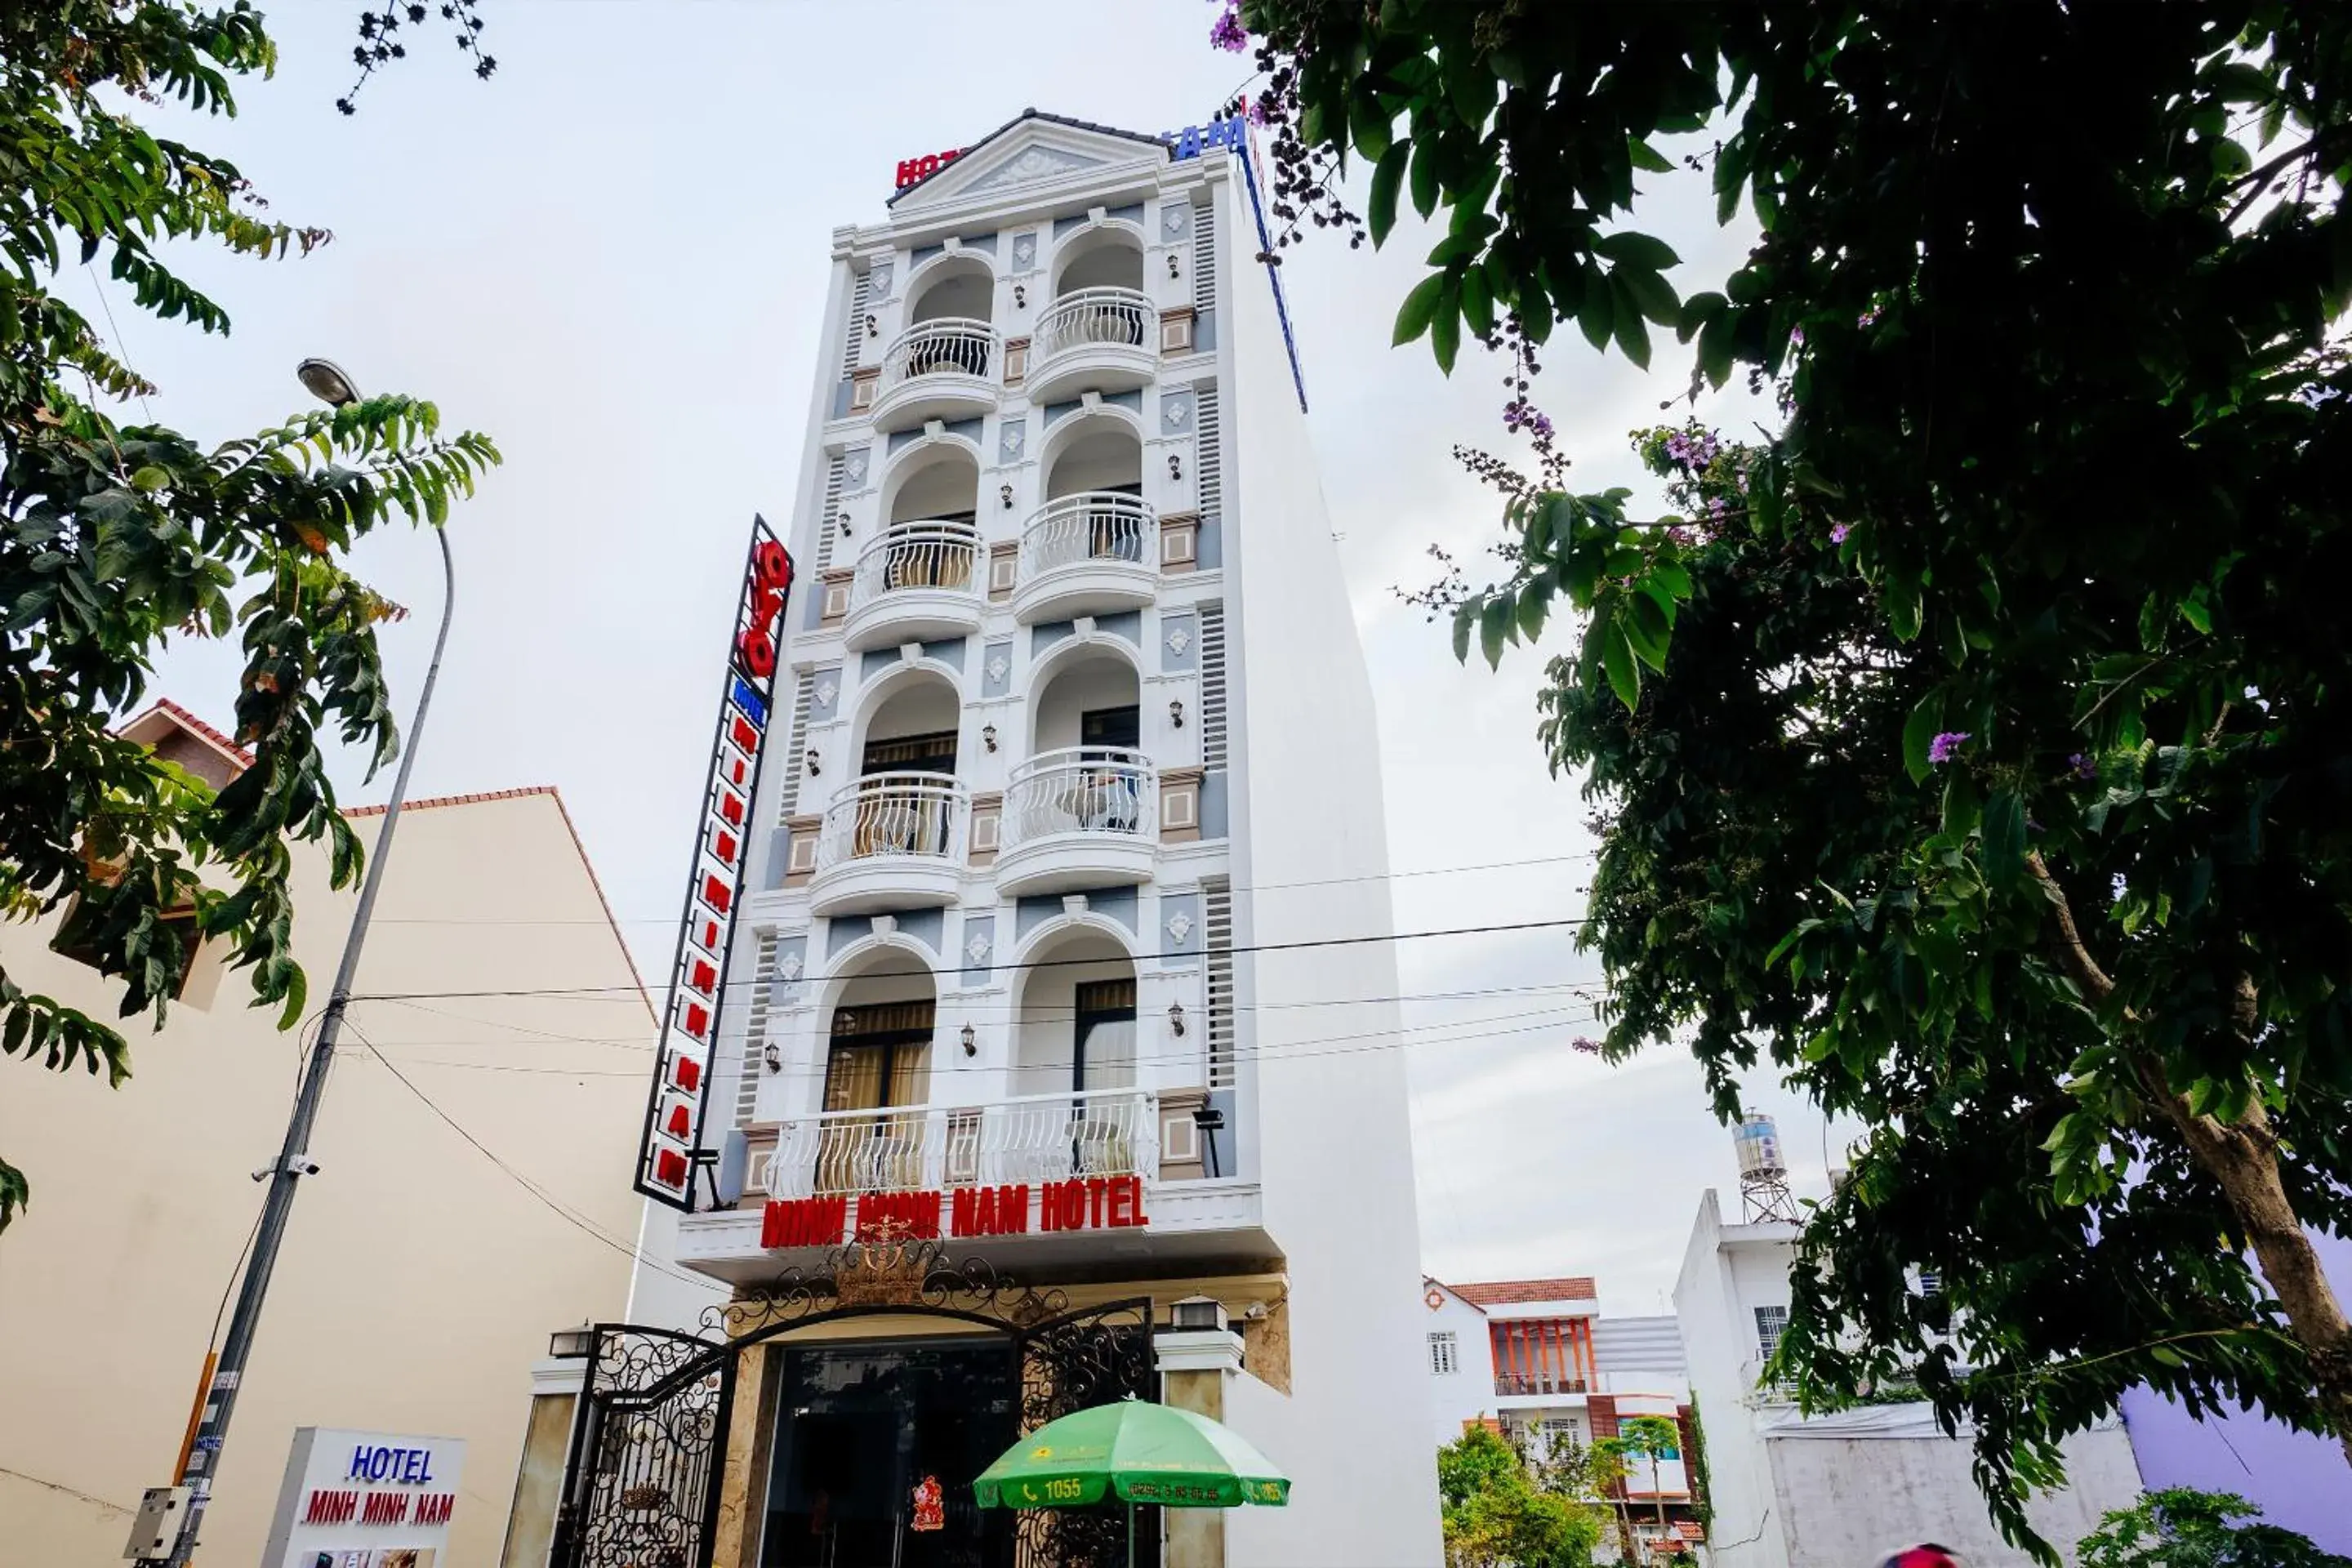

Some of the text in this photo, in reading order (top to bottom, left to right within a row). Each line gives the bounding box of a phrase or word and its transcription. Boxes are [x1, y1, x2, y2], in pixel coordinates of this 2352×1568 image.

[1161, 116, 1245, 160] AM
[737, 540, 790, 678] OYO
[657, 1055, 700, 1188] NAM
[761, 1175, 1150, 1248] MINH MINH NAM HOTEL
[350, 1446, 433, 1481] HOTEL
[306, 1490, 455, 1524] MINH MINH NAM
[1045, 1477, 1082, 1499] 1055
